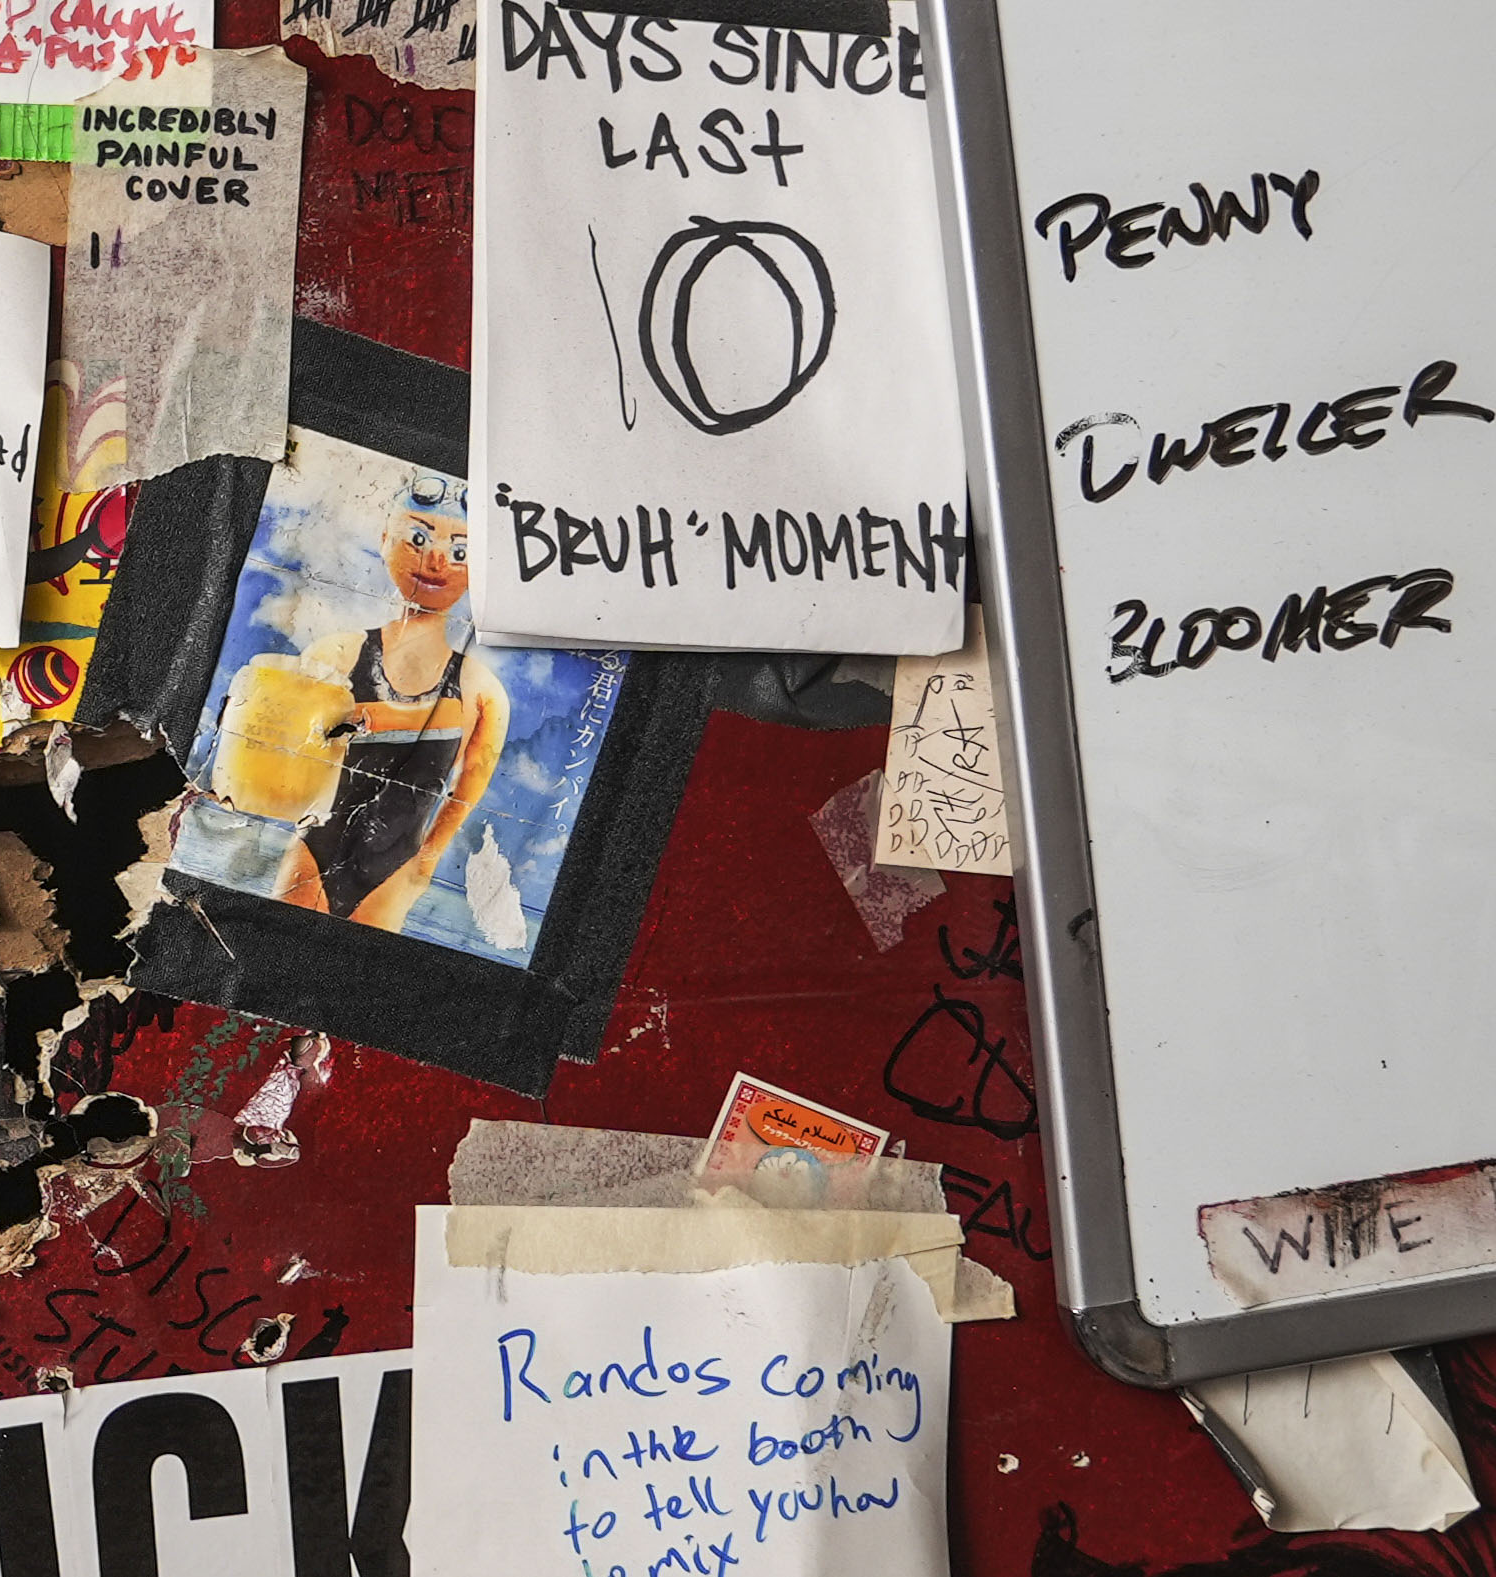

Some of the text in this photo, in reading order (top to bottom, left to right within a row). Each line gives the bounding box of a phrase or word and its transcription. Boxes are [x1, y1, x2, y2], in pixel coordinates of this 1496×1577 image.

[501, 0, 682, 94] DAYS
[82, 105, 277, 141] INCREDIBLY
[96, 140, 259, 172] PAINFUL
[125, 175, 251, 207] COVER
[1033, 167, 1322, 283] PENNY
[497, 1327, 732, 1423] Randos
[748, 1415, 872, 1466] booth
[562, 1499, 616, 1554] to
[643, 1476, 734, 1522] tell
